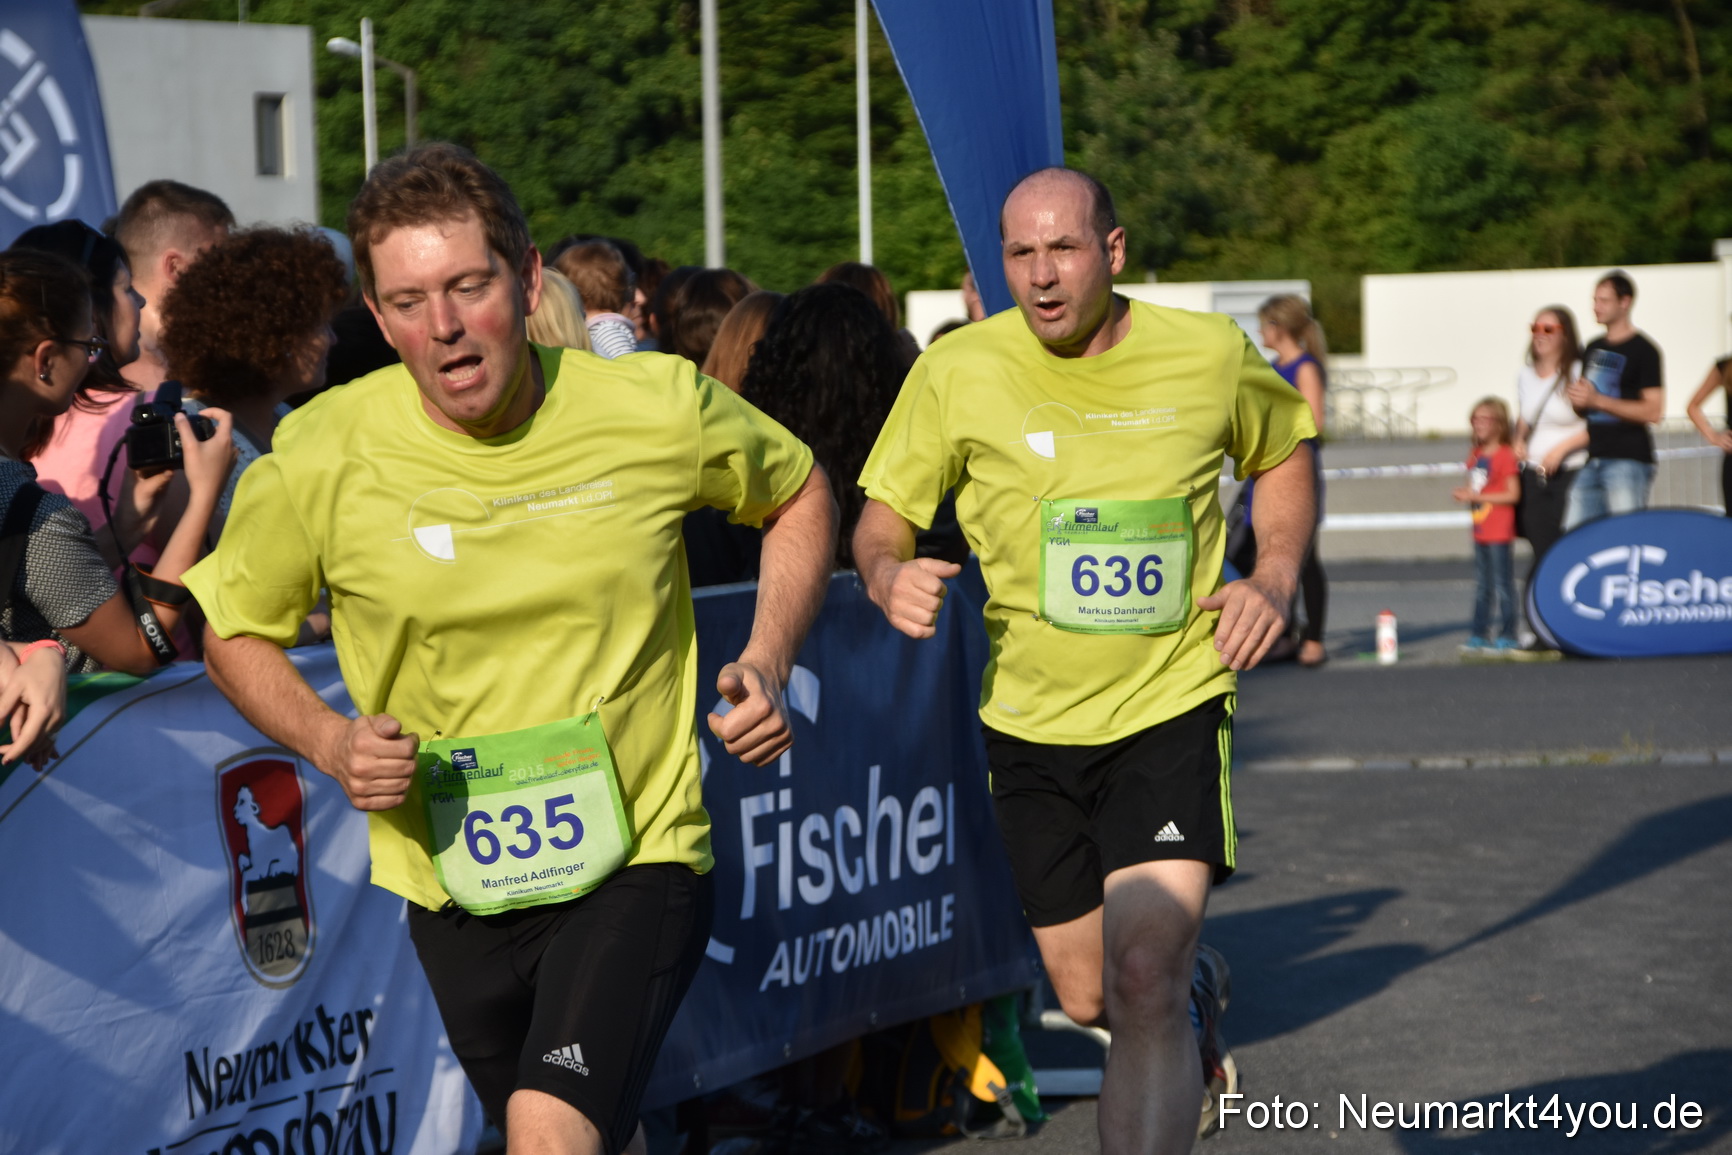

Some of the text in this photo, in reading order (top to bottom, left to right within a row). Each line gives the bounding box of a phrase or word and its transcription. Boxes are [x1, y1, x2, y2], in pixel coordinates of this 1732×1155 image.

[1111, 418, 1150, 427] Neumarkt
[492, 480, 613, 507] Kliniken des Landkreises
[527, 495, 579, 512] Neumarkt
[1064, 521, 1119, 532] firmenlauf
[1120, 528, 1148, 538] 2015
[1071, 554, 1164, 597] 636
[1078, 606, 1156, 615] Markus Danhardt
[140, 612, 169, 654] SONY
[443, 763, 504, 782] firmenlauf
[508, 764, 544, 781] 2015
[464, 793, 584, 865] 635
[1154, 834, 1185, 842] adidas
[481, 861, 585, 889] Manfred Adlfinger
[507, 881, 564, 896] Klinikum Neumarkt
[258, 929, 295, 965] 1628
[759, 893, 955, 992] AUTOMOBILE
[542, 1054, 590, 1076] adidas
